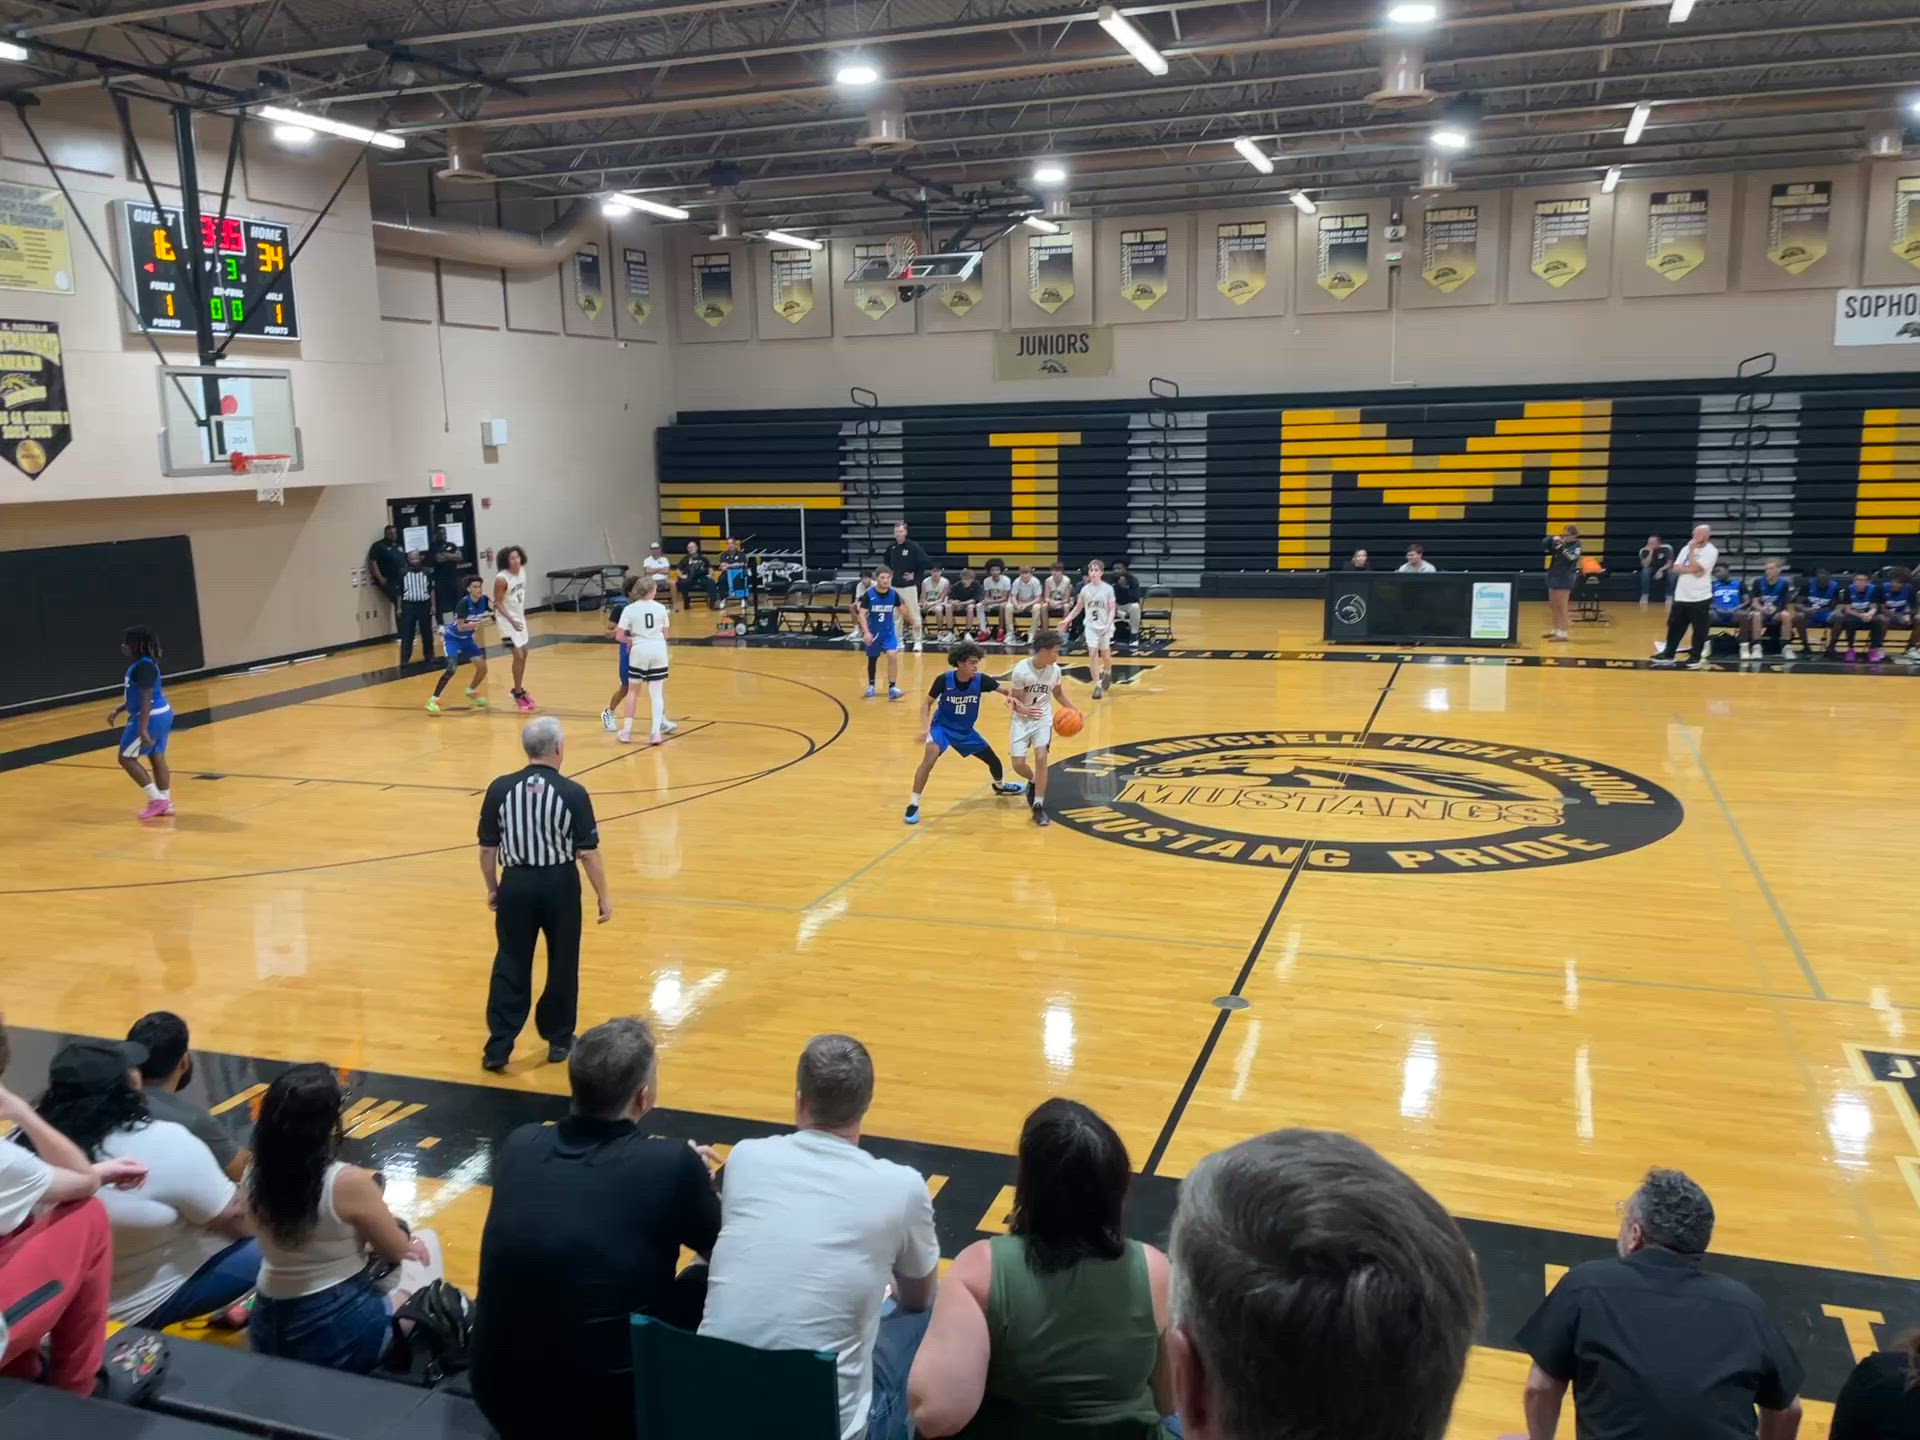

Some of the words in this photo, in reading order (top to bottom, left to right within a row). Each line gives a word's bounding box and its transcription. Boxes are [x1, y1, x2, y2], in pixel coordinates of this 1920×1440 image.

[133, 208, 175, 226] GUET
[250, 225, 282, 241] HOME
[256, 242, 284, 272] 34
[225, 258, 238, 280] 3
[166, 294, 174, 316] 1
[274, 303, 283, 325] 1
[1016, 333, 1089, 356] JUNIORS
[645, 613, 654, 629] 0
[878, 612, 885, 623] 3
[1091, 610, 1099, 621] 5
[954, 703, 967, 715] 10
[1135, 733, 1366, 755] MITCHELL
[1383, 735, 1520, 759] HIGH
[1512, 755, 1657, 806] SCHOOL
[1112, 782, 1566, 826] MUSTANGS
[1058, 805, 1351, 869] MUSTANG
[1386, 833, 1611, 869] PRIDE
